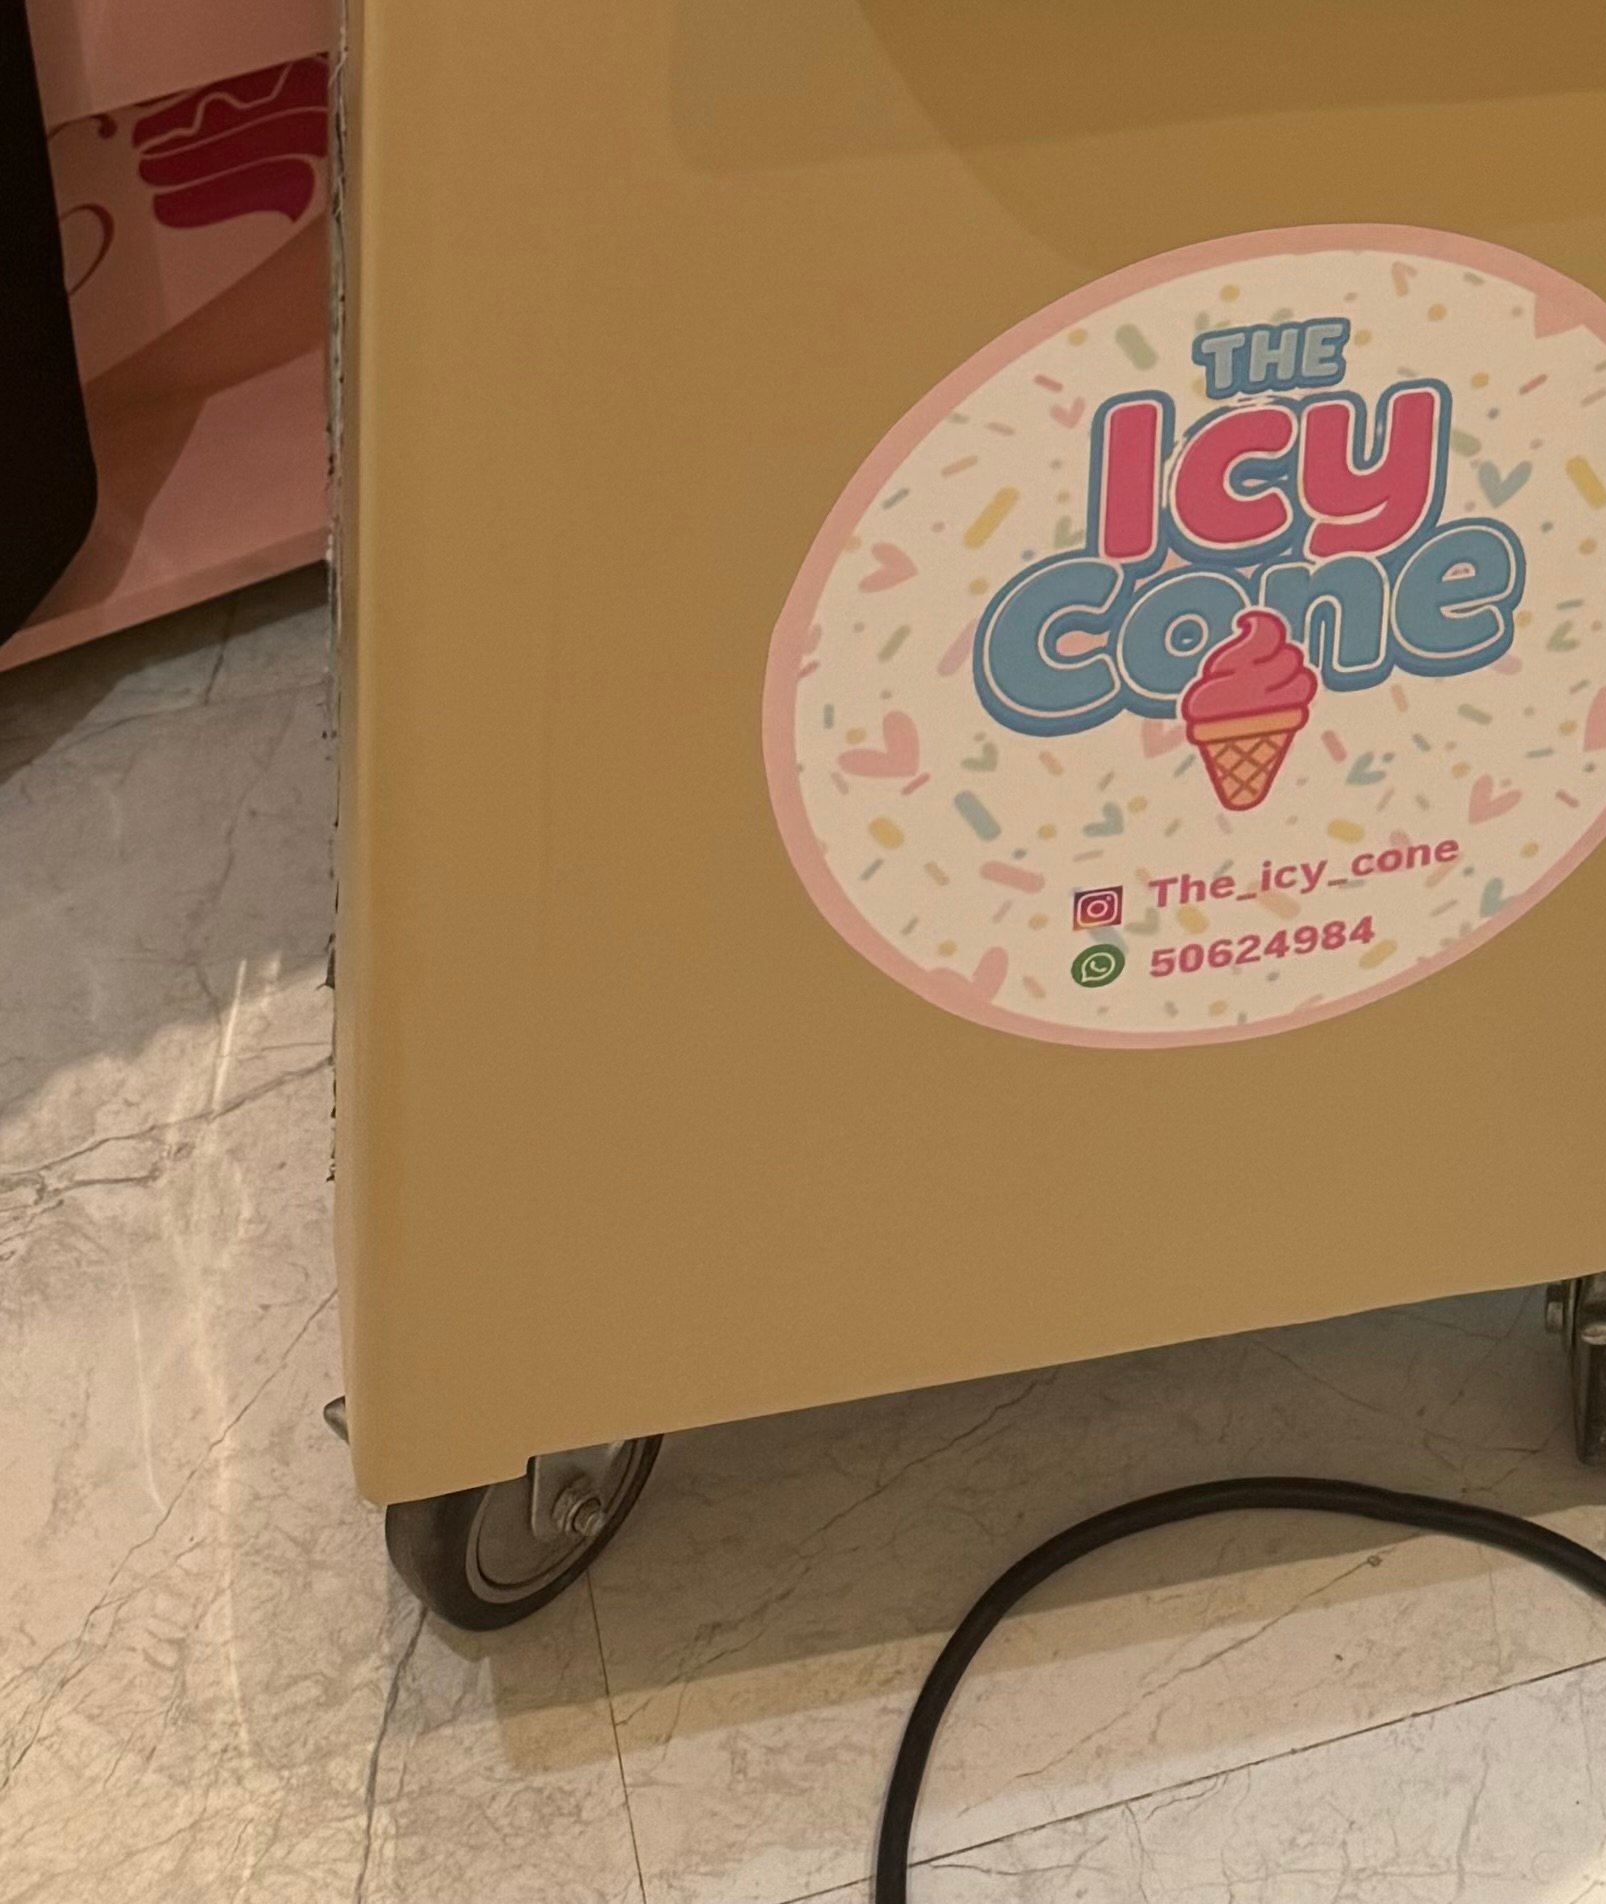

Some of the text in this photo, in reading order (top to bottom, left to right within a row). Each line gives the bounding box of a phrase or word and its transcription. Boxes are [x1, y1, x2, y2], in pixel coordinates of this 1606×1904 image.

[1195, 319, 1348, 396] THE
[1148, 839, 1460, 908] The_icy_cone
[1150, 915, 1376, 978] 50624984
